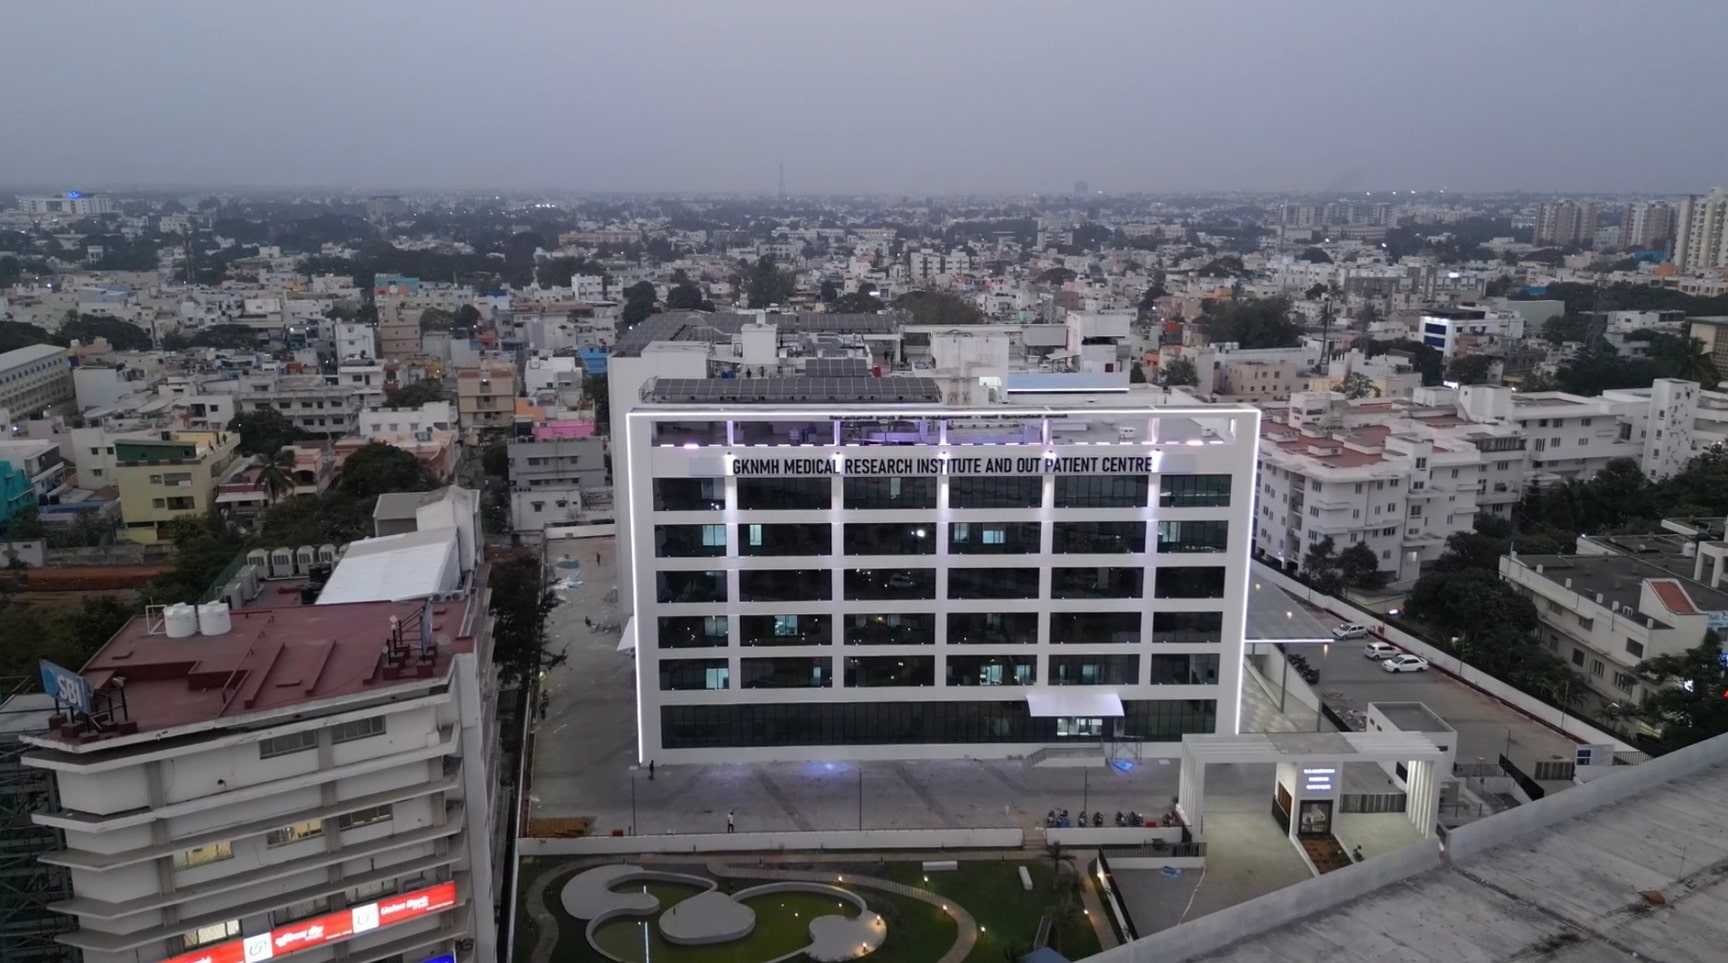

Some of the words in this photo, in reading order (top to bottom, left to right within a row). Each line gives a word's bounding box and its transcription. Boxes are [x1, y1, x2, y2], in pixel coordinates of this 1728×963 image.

[733, 459, 779, 474] GKNMH
[784, 459, 840, 474] MEDICAL
[845, 458, 912, 474] RESEARCH
[917, 458, 981, 473] INSTITUTE
[985, 458, 1013, 473] AND
[1016, 457, 1042, 473] OUT
[1045, 457, 1099, 473] PATIENT
[1102, 457, 1153, 472] CENTRE
[57, 675, 83, 707] SBI
